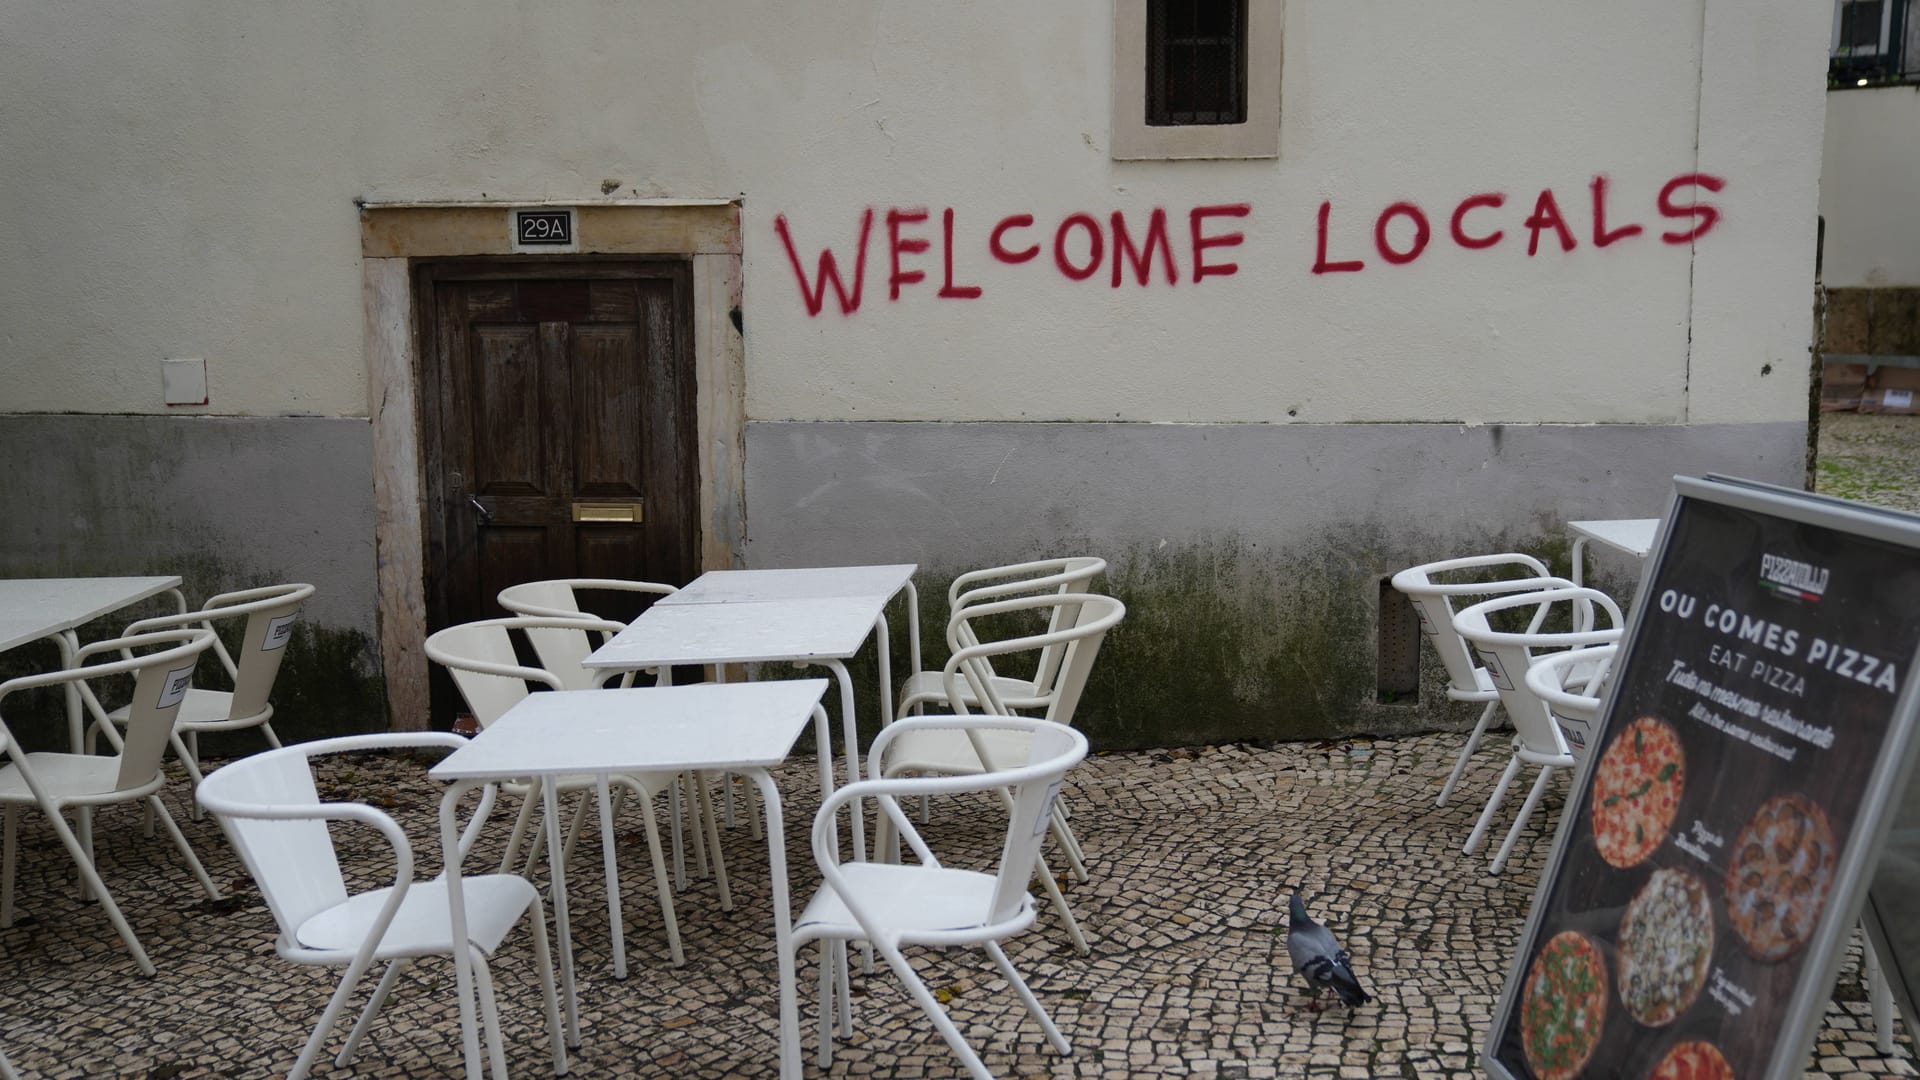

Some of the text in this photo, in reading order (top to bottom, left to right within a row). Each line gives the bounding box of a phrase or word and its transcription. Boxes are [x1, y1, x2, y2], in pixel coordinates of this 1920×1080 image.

[523, 218, 565, 238] 29A
[774, 171, 1728, 317] WELCOME LOCALS
[1659, 589, 1898, 694] OU COMES PIZZA
[1708, 644, 1807, 698] EAT PIZZA
